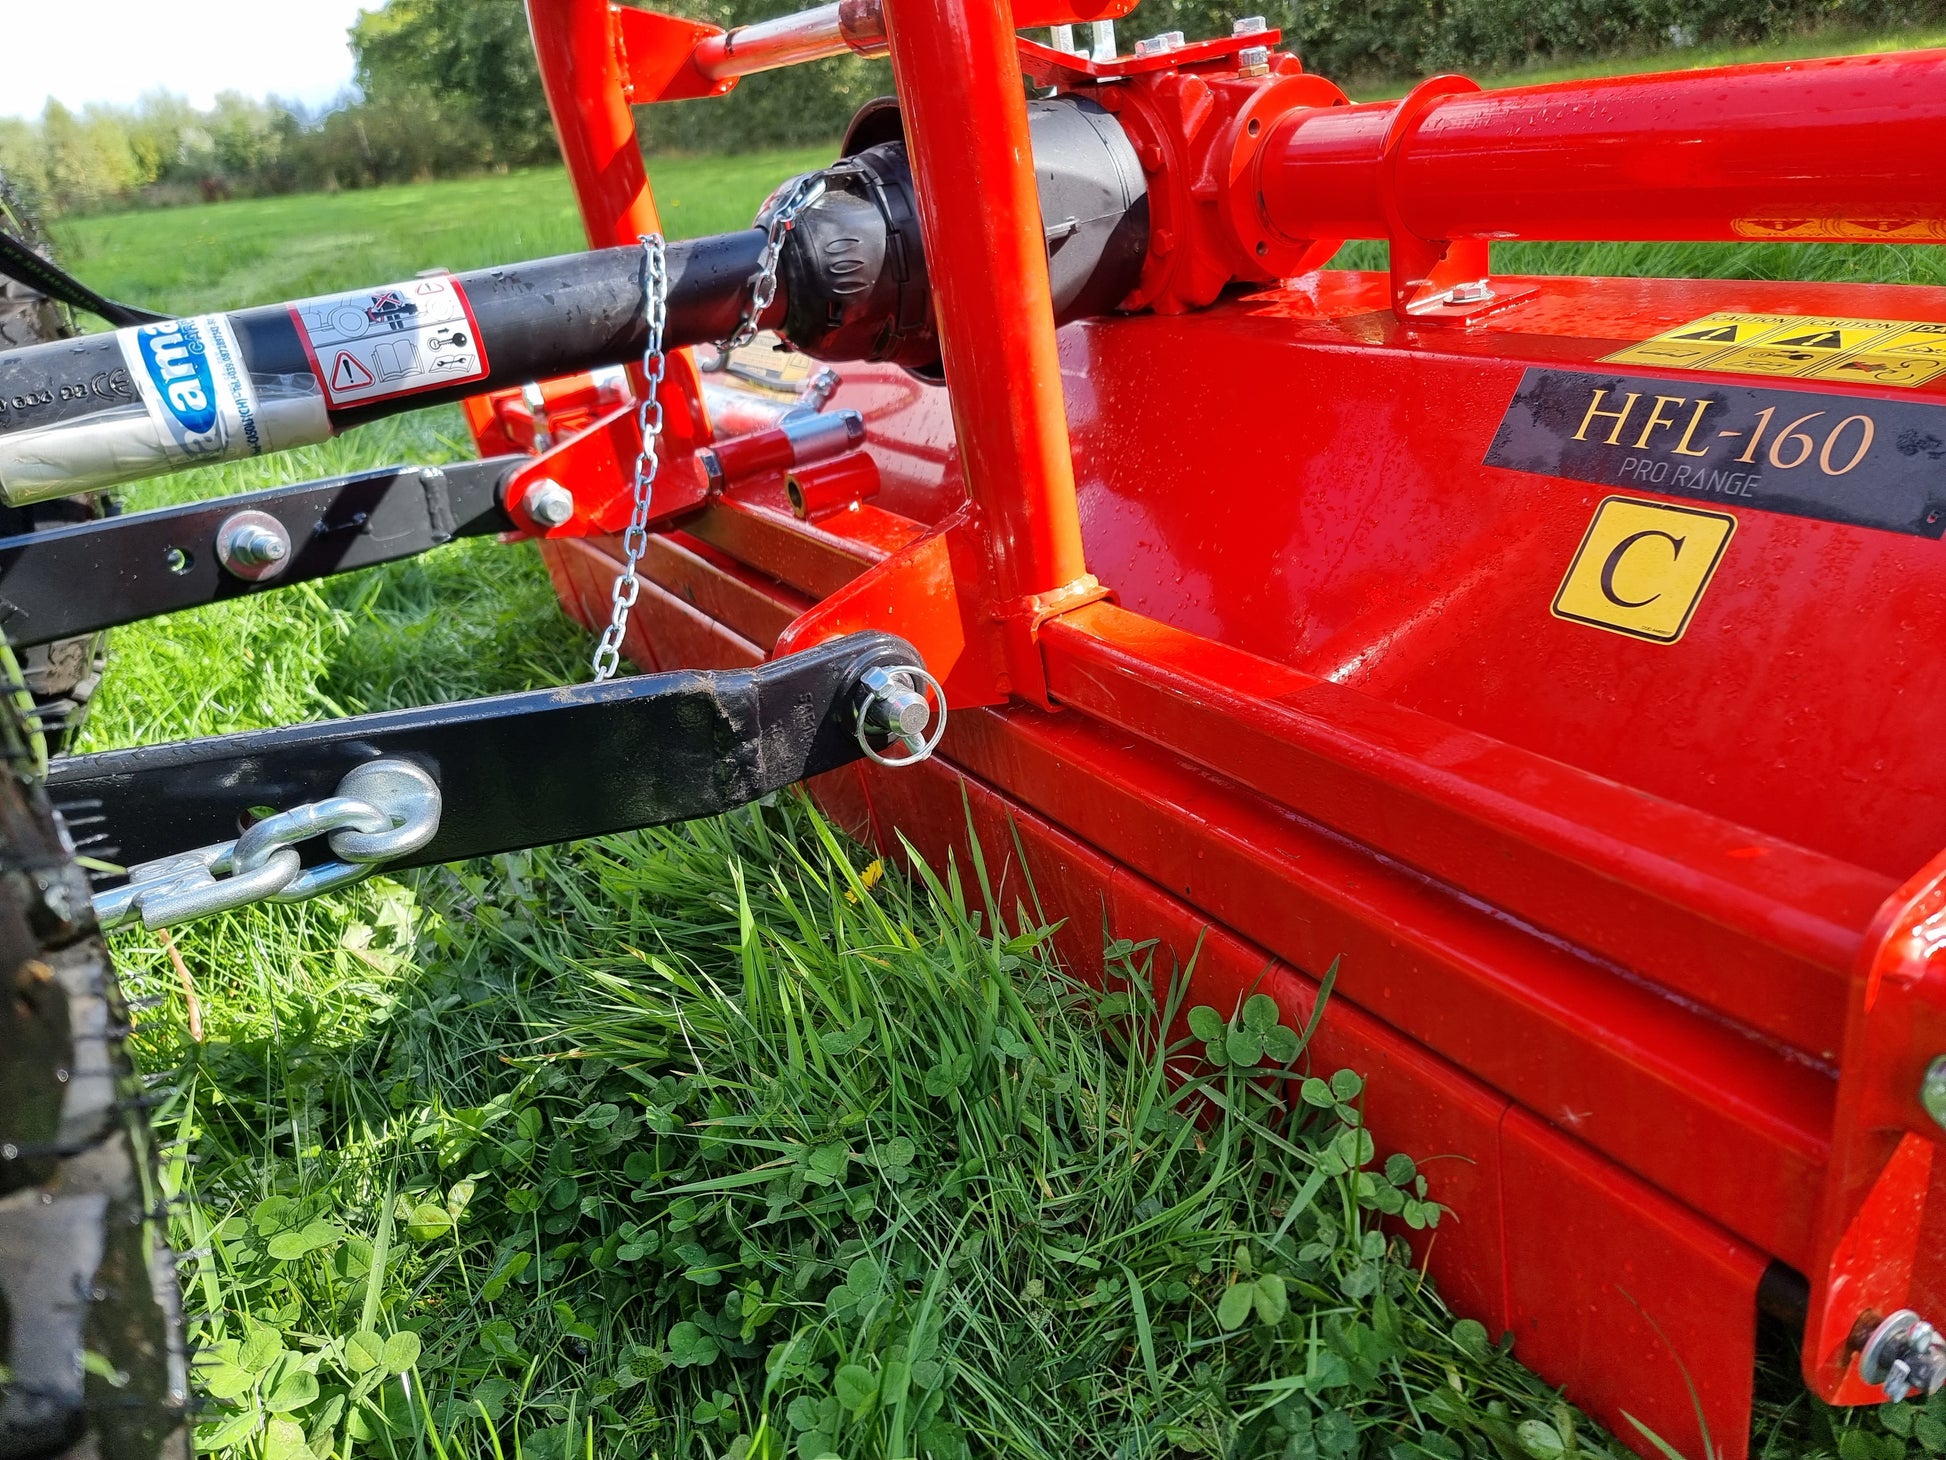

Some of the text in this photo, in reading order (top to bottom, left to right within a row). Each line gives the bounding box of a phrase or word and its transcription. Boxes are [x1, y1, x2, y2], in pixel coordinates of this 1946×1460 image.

[1711, 315, 1786, 324] CAUTION
[1809, 319, 1896, 330] CAUTION
[1571, 389, 1875, 476] HFL-160
[1617, 457, 1763, 497] PRO RANGE
[1600, 530, 1687, 608] C
